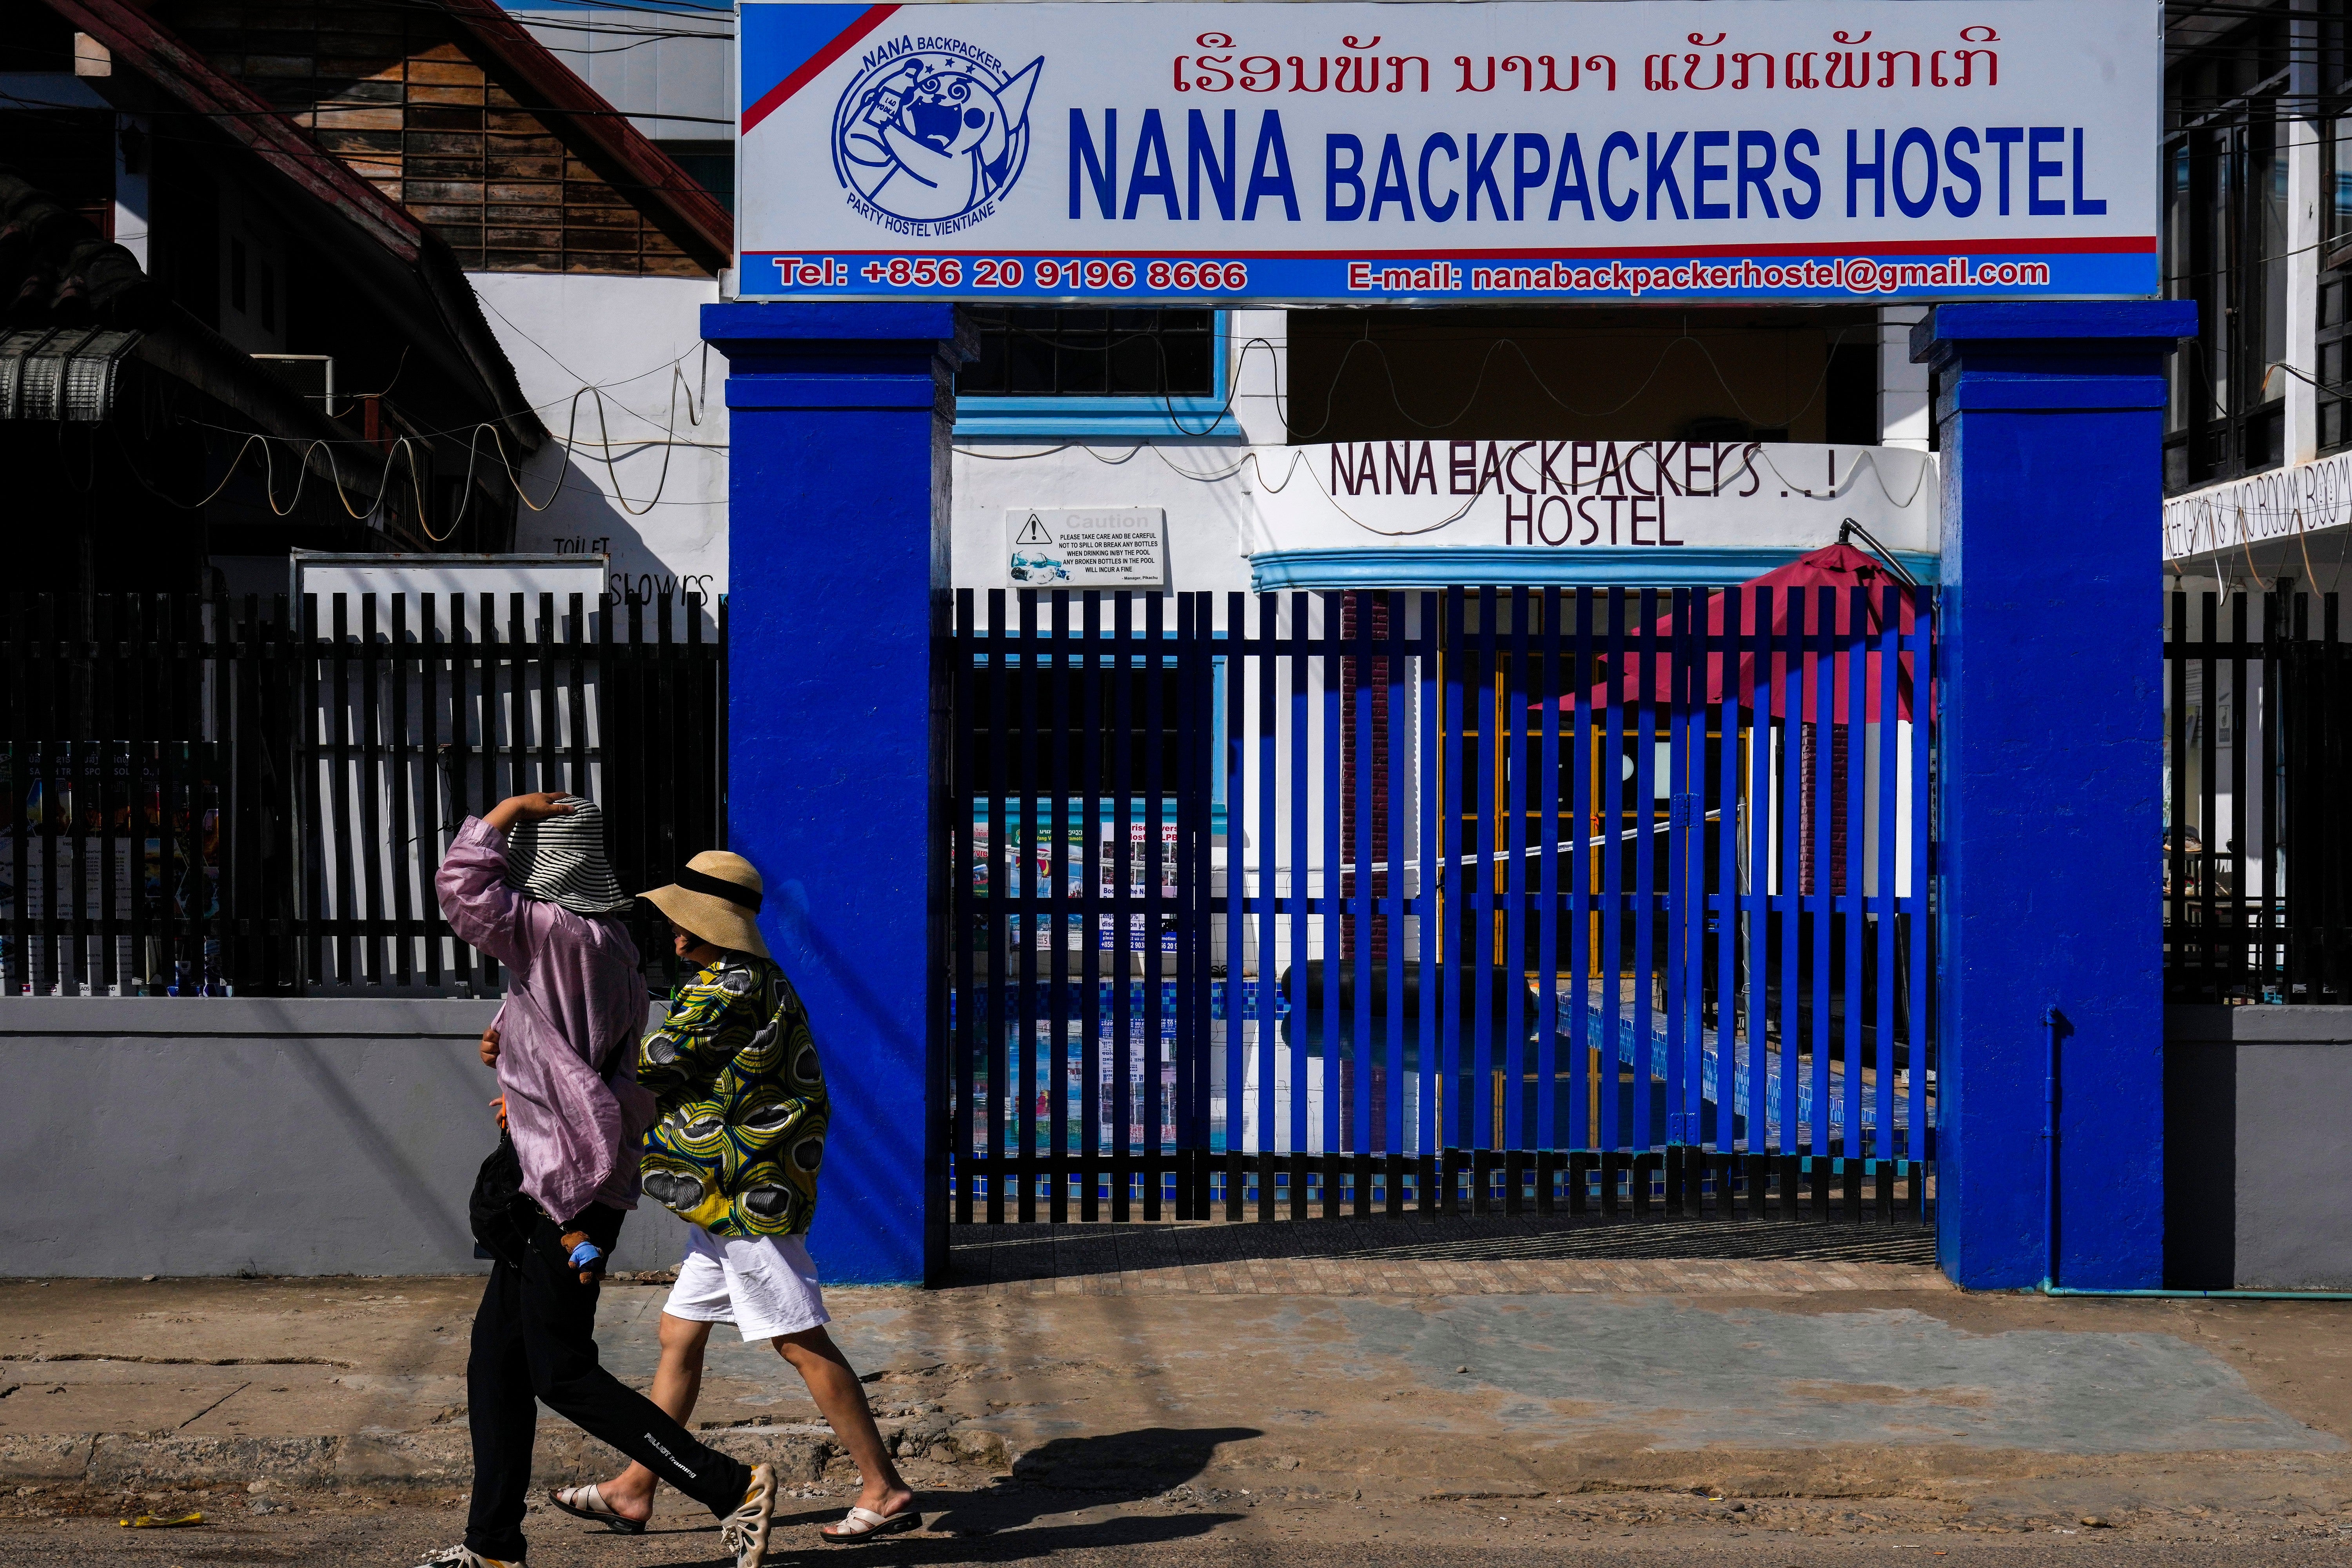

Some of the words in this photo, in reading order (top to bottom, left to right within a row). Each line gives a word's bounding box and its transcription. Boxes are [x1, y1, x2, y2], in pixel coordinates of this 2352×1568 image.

[863, 35, 913, 72] NANA
[917, 36, 1002, 74] BACKPACKER
[1455, 55, 1615, 92] ນານາ
[1069, 108, 1301, 221] NANA
[1326, 129, 1821, 223] BACKPACKERS
[1847, 126, 2107, 218] HOSTEL
[847, 192, 884, 225] PARTY
[885, 216, 931, 236] HOSTEL
[934, 201, 995, 236] VIENTIANE
[774, 259, 846, 284] Tel:
[863, 260, 961, 285] +856
[975, 260, 1023, 287] 20
[1036, 260, 1135, 288] 9196
[1148, 261, 1247, 289] 8666
[1349, 263, 1460, 289] E-mail:
[1473, 259, 2048, 295] nanabackpackerhostel@gmail.com
[1331, 441, 1437, 495] NANA
[1066, 514, 1148, 528] Caution
[1506, 495, 1684, 546] HOSTEL
[2163, 501, 2183, 558] REE
[2257, 471, 2304, 537] BOOM
[644, 1432, 671, 1457] PELLIOT
